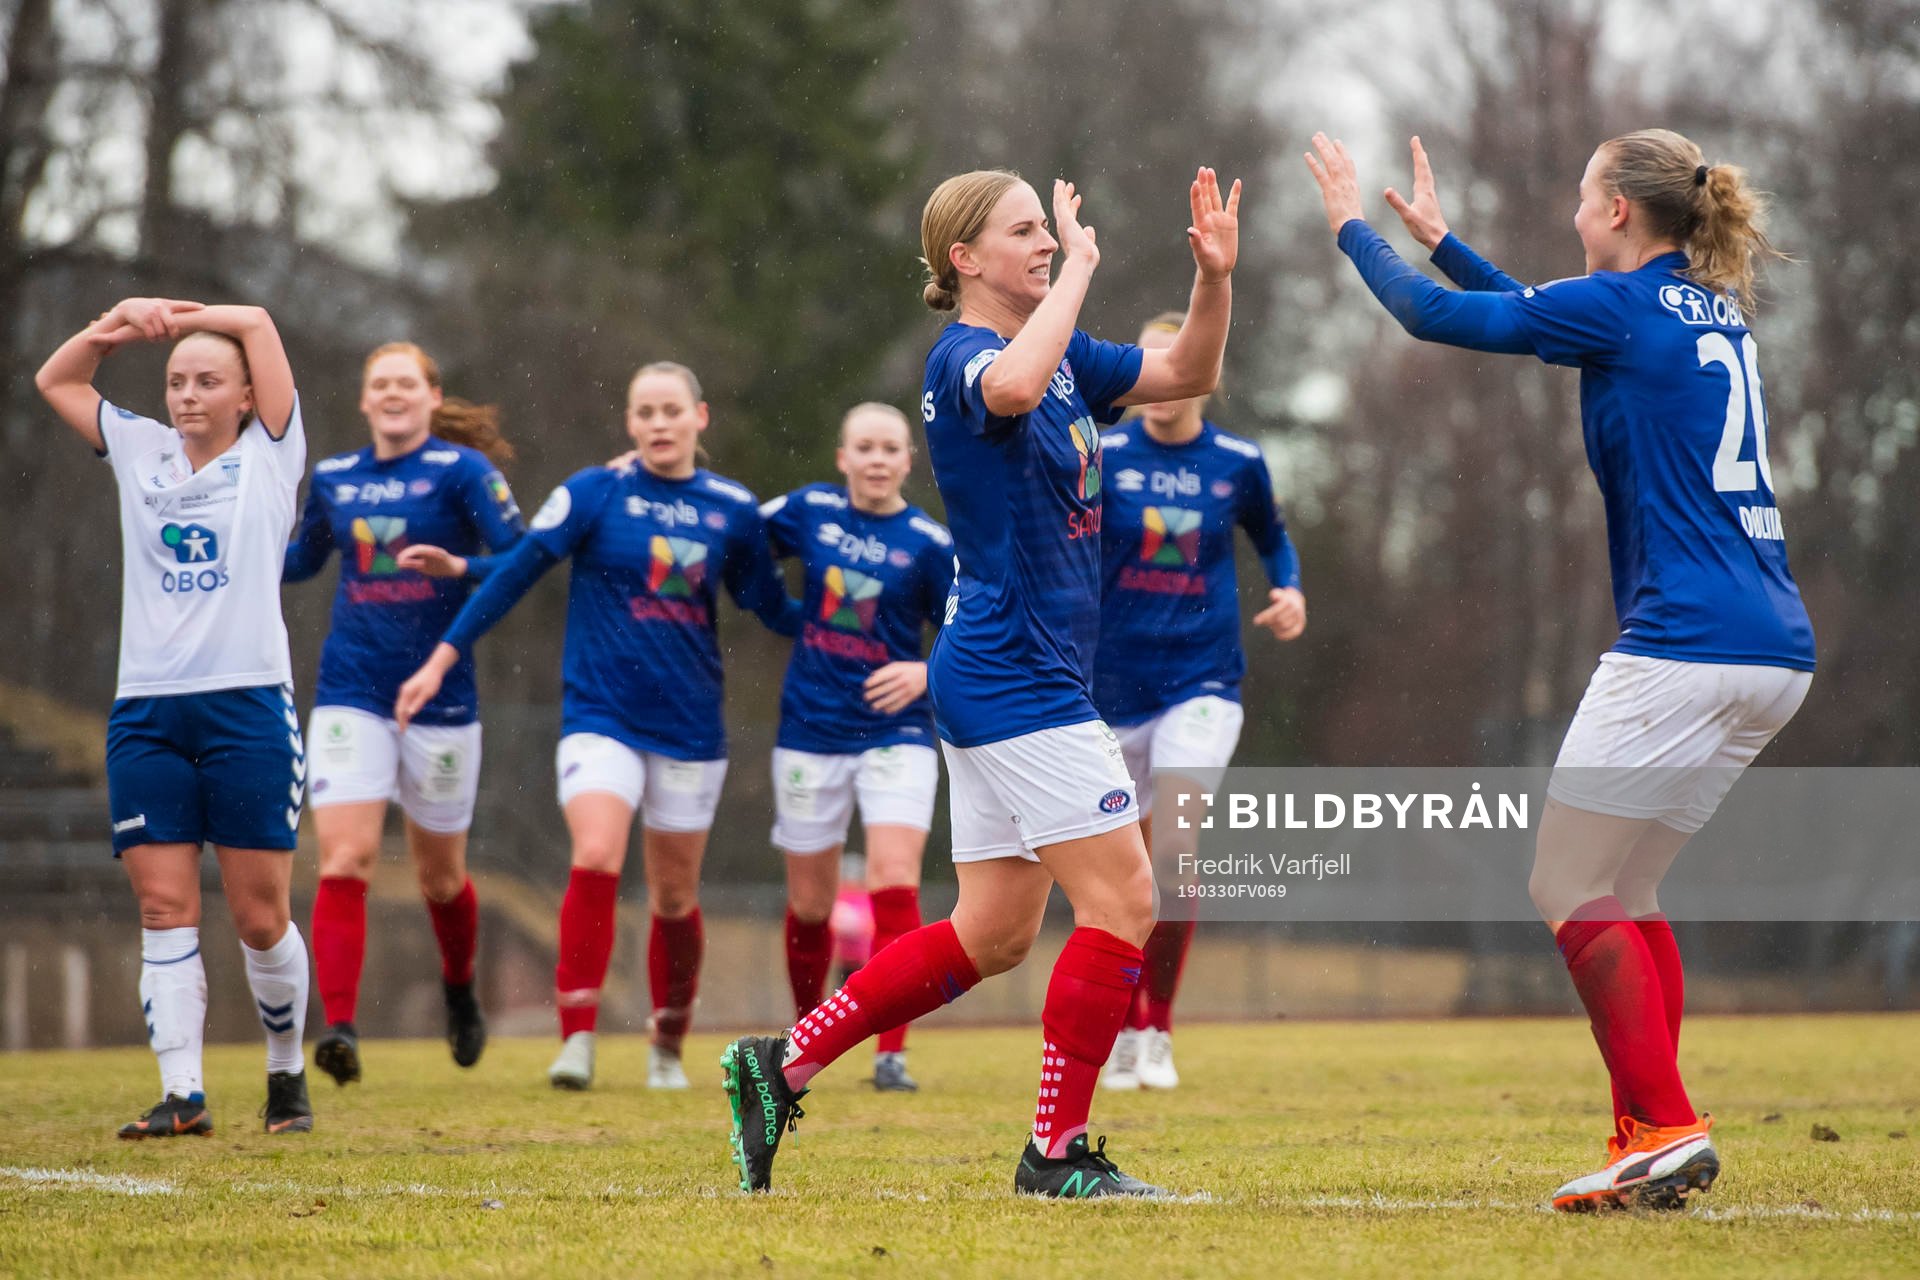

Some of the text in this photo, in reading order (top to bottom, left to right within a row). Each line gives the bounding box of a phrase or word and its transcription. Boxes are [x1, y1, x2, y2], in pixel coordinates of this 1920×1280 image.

[161, 566, 229, 593] OBOS
[744, 1046, 778, 1146] new balance
